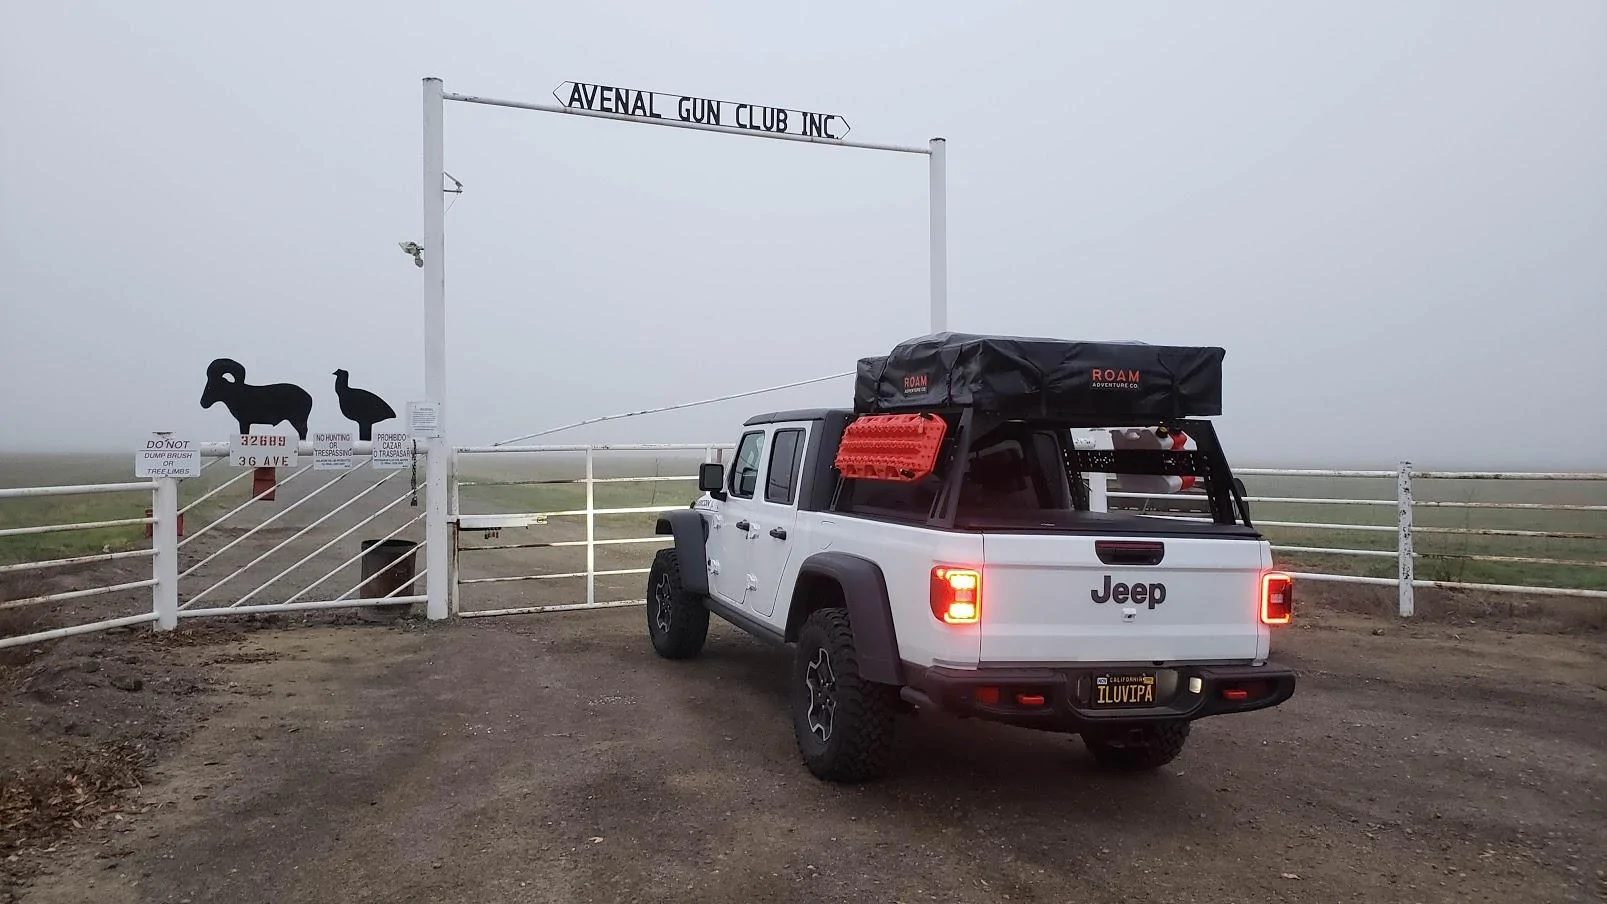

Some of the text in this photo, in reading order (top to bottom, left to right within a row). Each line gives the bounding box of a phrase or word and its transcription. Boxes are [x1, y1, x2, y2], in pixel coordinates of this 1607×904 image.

[567, 83, 661, 118] AVENAL
[678, 96, 721, 125] GUN
[735, 104, 788, 132] CLUB
[1092, 369, 1140, 382] ROAM
[904, 376, 928, 388] ROAM
[241, 435, 286, 447] 32689
[316, 434, 351, 442] NO HUNTING
[146, 440, 190, 449] DO NOT
[328, 441, 338, 449] OR
[382, 441, 402, 450] CAZAR
[314, 449, 352, 457] TRESPASSING
[379, 449, 411, 458] TRASPASAR
[263, 455, 289, 467] AVE
[1090, 575, 1167, 609] Jeep
[1097, 685, 1153, 704] ILUVIPA
